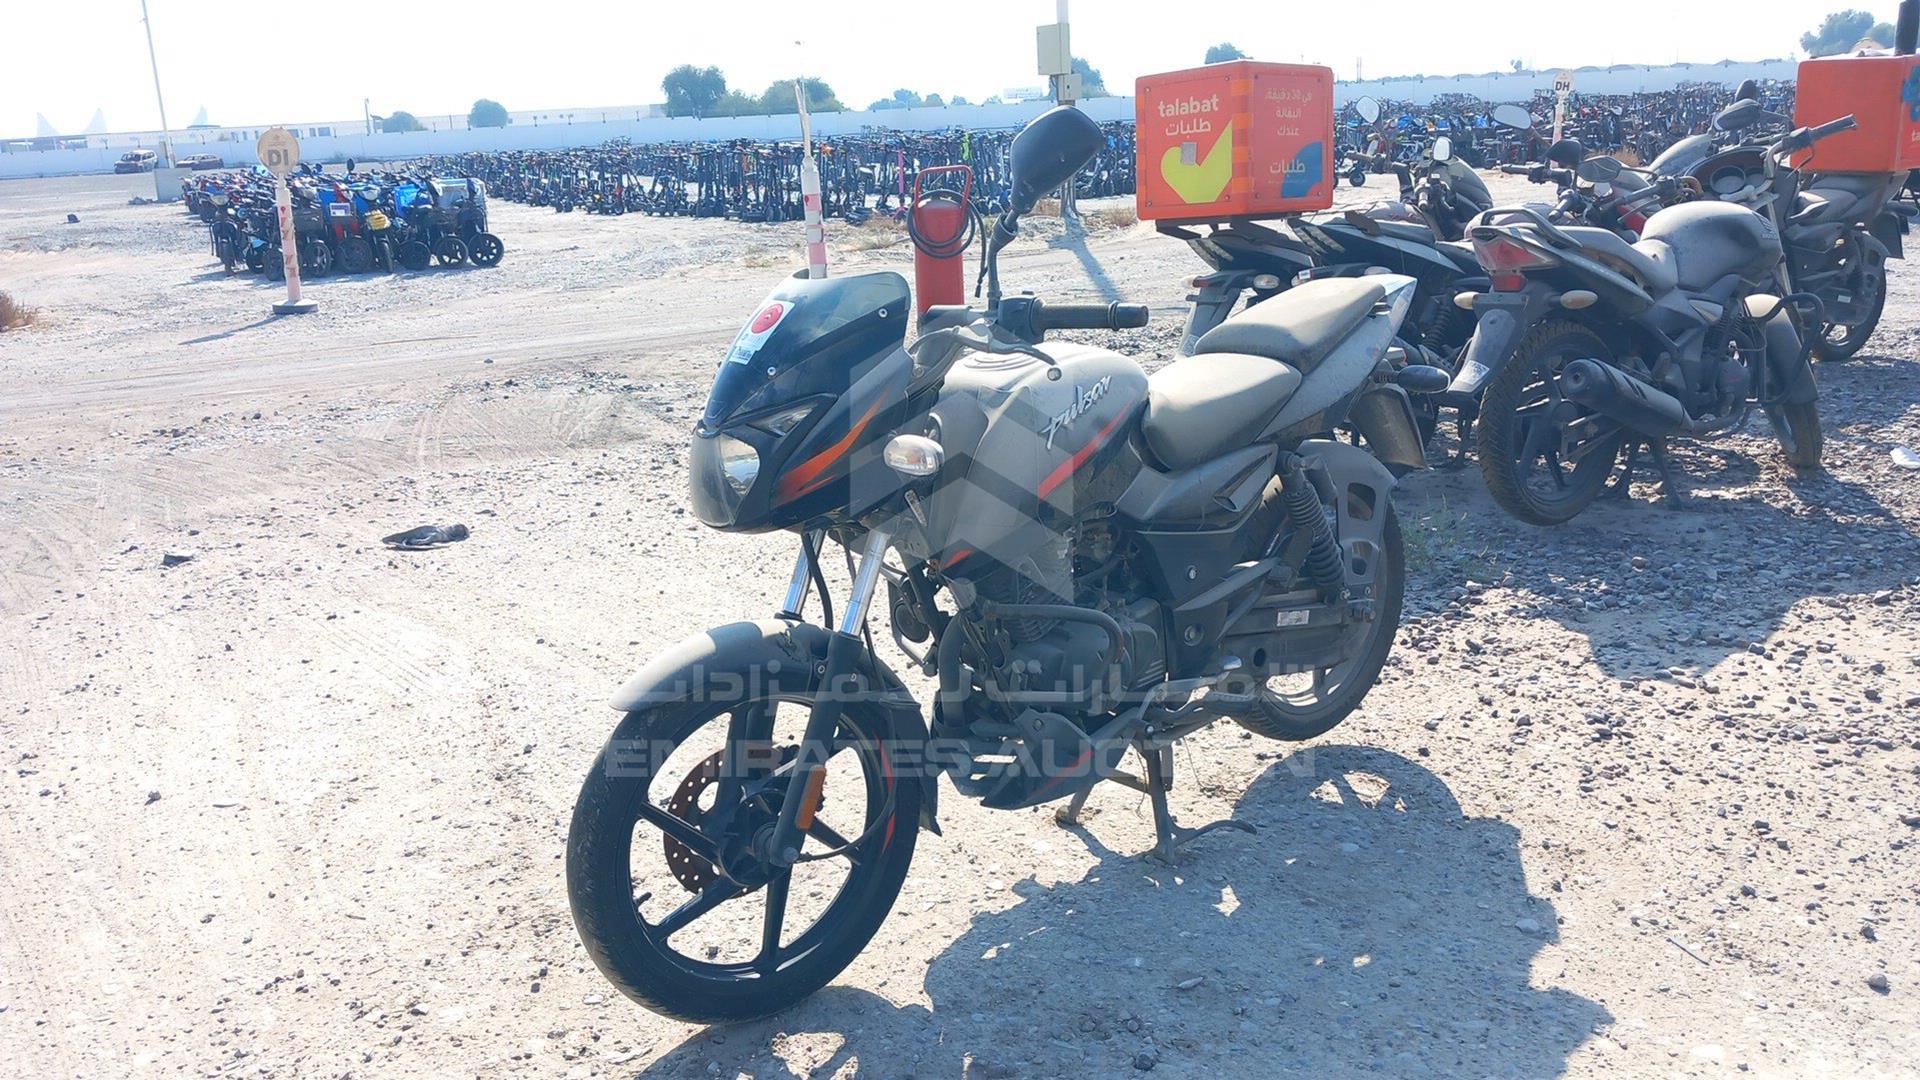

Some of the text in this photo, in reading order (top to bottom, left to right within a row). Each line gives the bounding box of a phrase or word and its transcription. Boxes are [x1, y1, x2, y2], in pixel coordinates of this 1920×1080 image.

[1555, 81, 1570, 91] DH
[1158, 94, 1219, 118] talabat
[1165, 119, 1212, 139] طلبات
[268, 149, 289, 167] DI
[1269, 159, 1306, 178] طلبات
